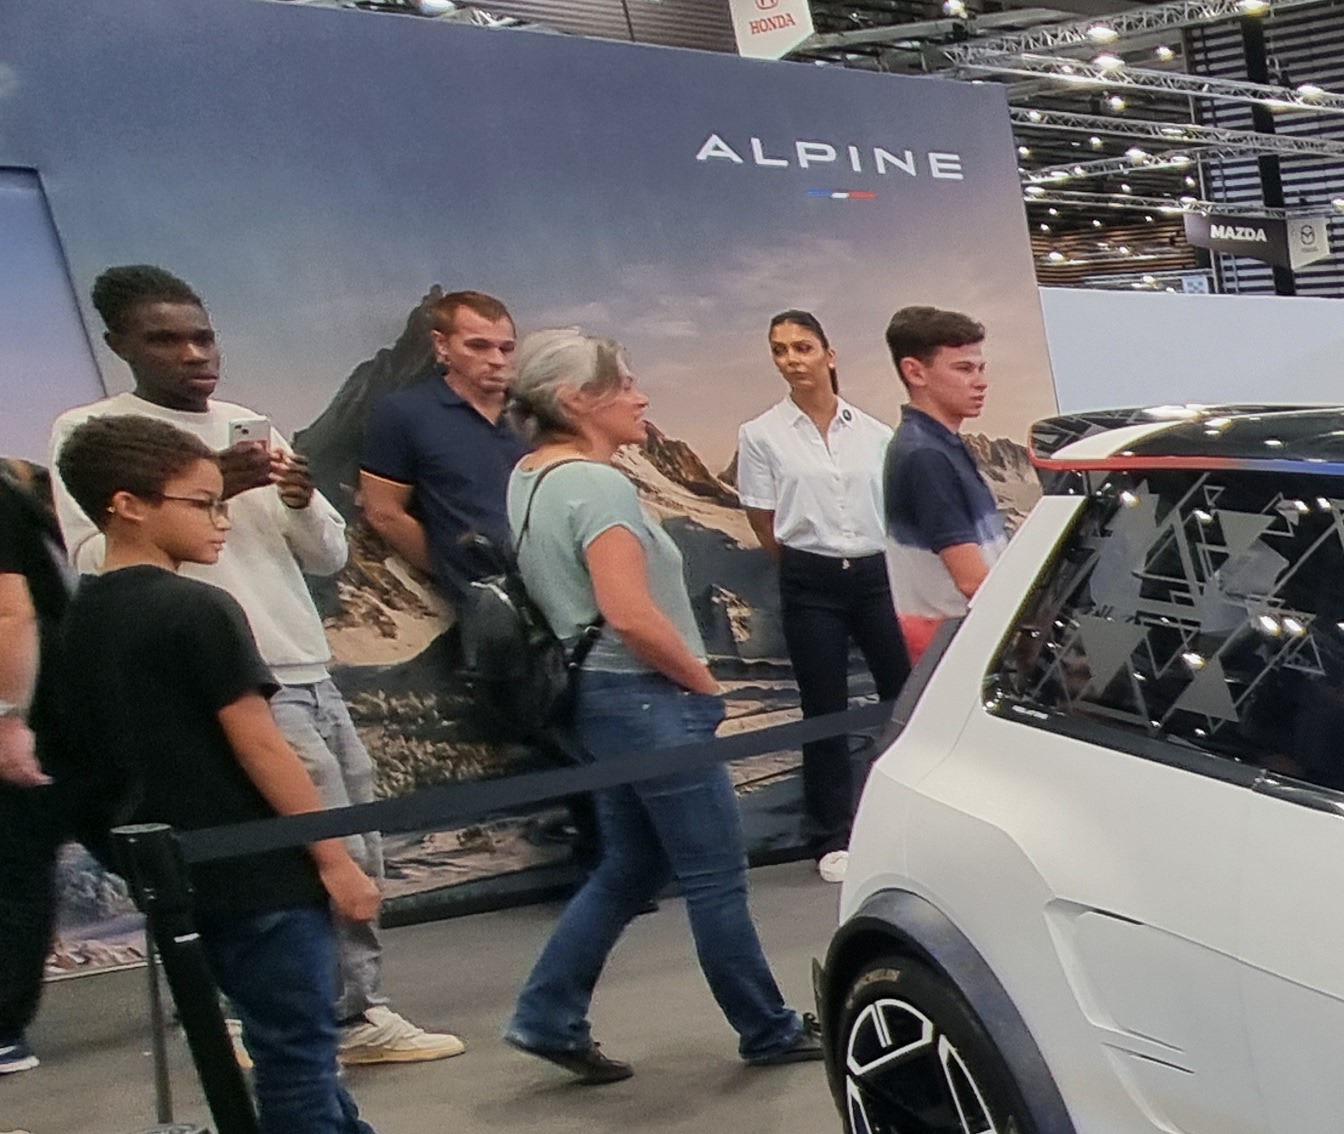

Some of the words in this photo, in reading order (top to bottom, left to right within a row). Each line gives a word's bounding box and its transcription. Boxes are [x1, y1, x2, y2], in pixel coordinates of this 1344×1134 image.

[749, 13, 796, 34] HONDA
[696, 134, 963, 180] ALPINE
[1210, 224, 1268, 243] MAZDA
